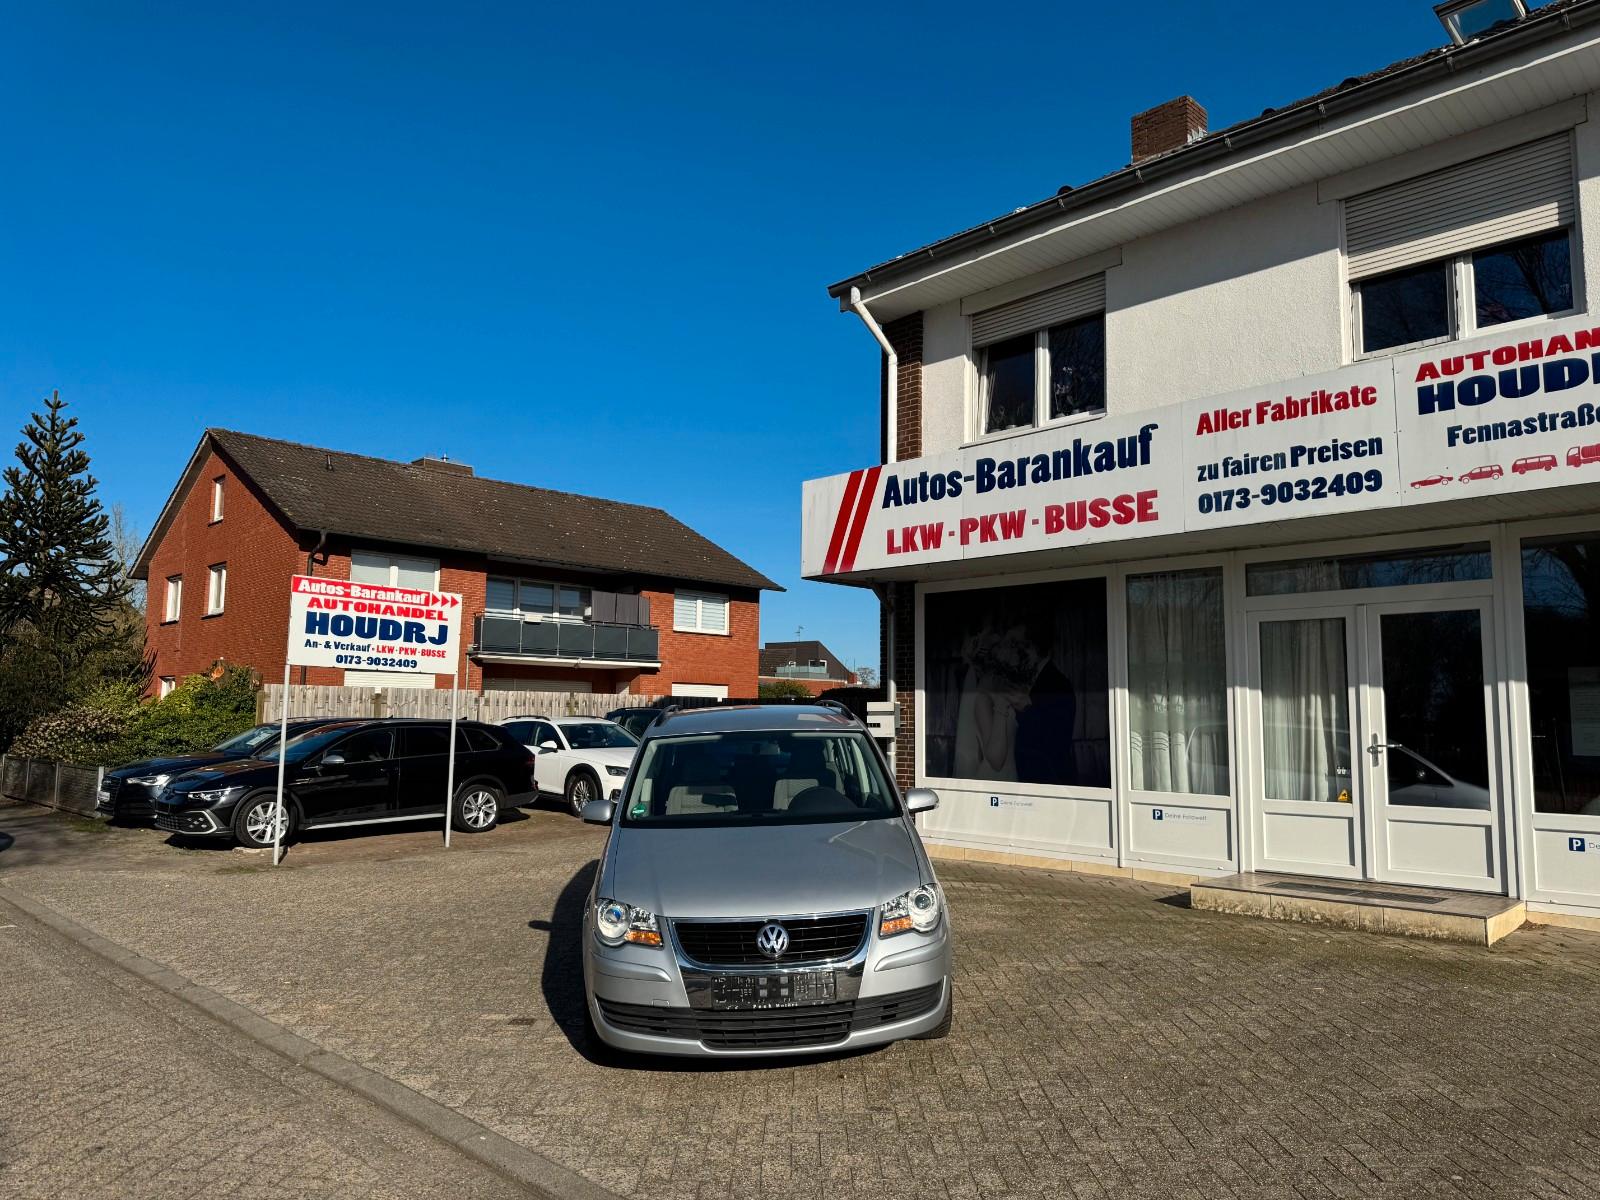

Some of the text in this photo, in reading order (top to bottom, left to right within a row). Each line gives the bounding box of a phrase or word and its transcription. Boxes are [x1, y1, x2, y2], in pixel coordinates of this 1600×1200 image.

[1417, 352, 1600, 416] HOUD
[1196, 386, 1377, 436] Aller Fabrikate
[881, 423, 1159, 510] Autos-Barankauf
[1197, 437, 1383, 483] zu fairen Preisen
[1198, 469, 1383, 514] 0173-9032409
[886, 522, 945, 555] LKW
[959, 510, 1026, 545] PKW
[1044, 490, 1158, 535] BUSSE
[298, 579, 428, 605] Autos-Barankauf
[307, 596, 449, 622] AUTOHANDEL
[304, 610, 449, 646] HOUDRJ
[334, 641, 372, 653] Verkauf
[376, 644, 395, 655] LKW
[398, 646, 418, 656] PKW
[420, 648, 447, 659] BUSSE
[335, 654, 418, 669] 0173-9032409
